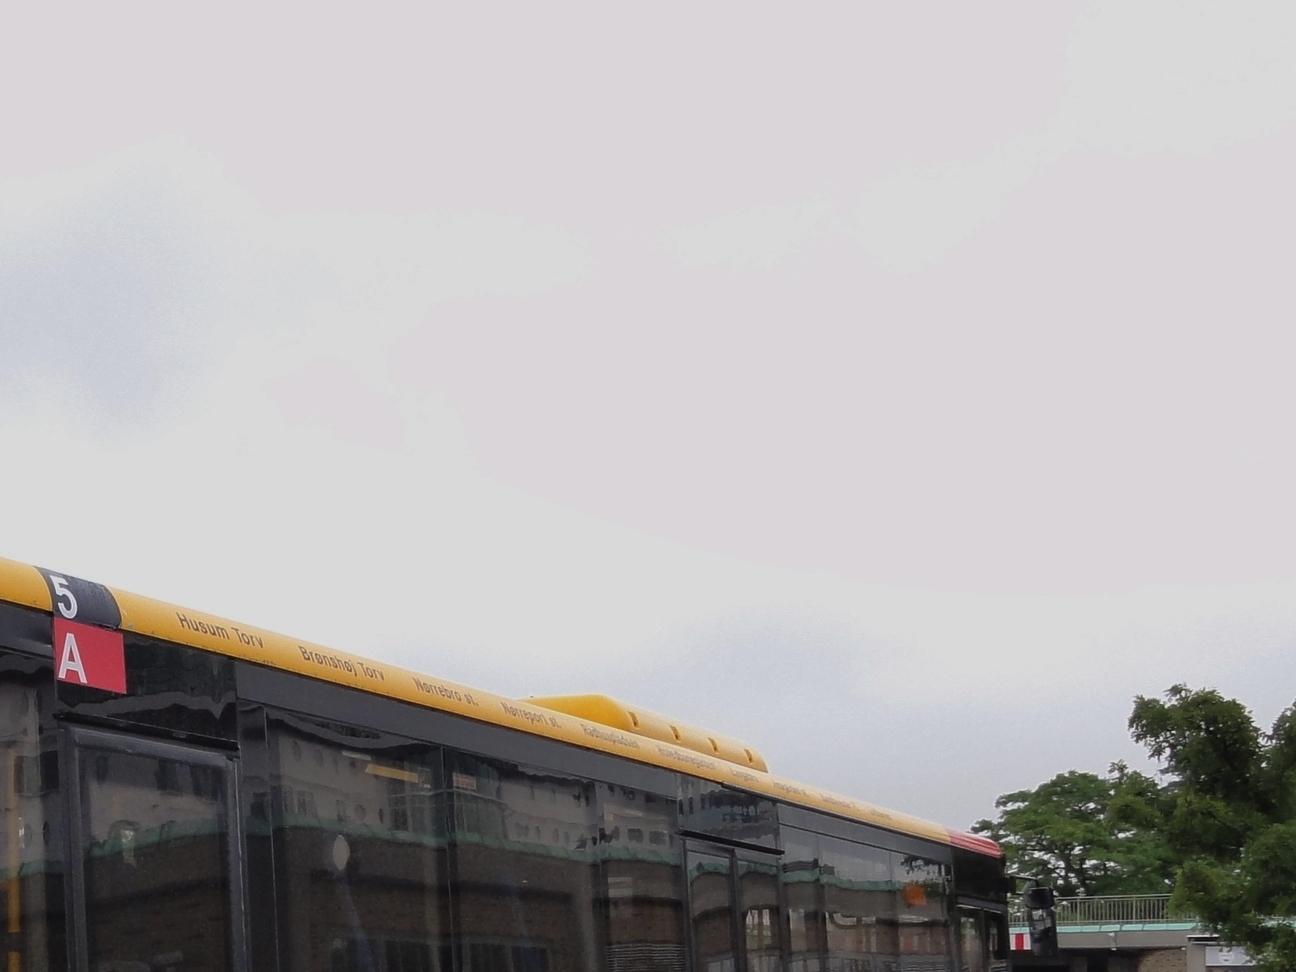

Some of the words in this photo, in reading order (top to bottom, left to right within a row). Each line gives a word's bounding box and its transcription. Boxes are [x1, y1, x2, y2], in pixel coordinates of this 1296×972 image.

[49, 574, 78, 619] 5
[176, 612, 230, 640] Husum
[231, 627, 264, 649] Torv
[58, 633, 87, 684] A
[298, 645, 357, 677] Brønshøj
[358, 661, 385, 682] Torv
[412, 677, 462, 702] Nørrebro
[464, 693, 479, 706] st.
[500, 702, 548, 725] Nørreport
